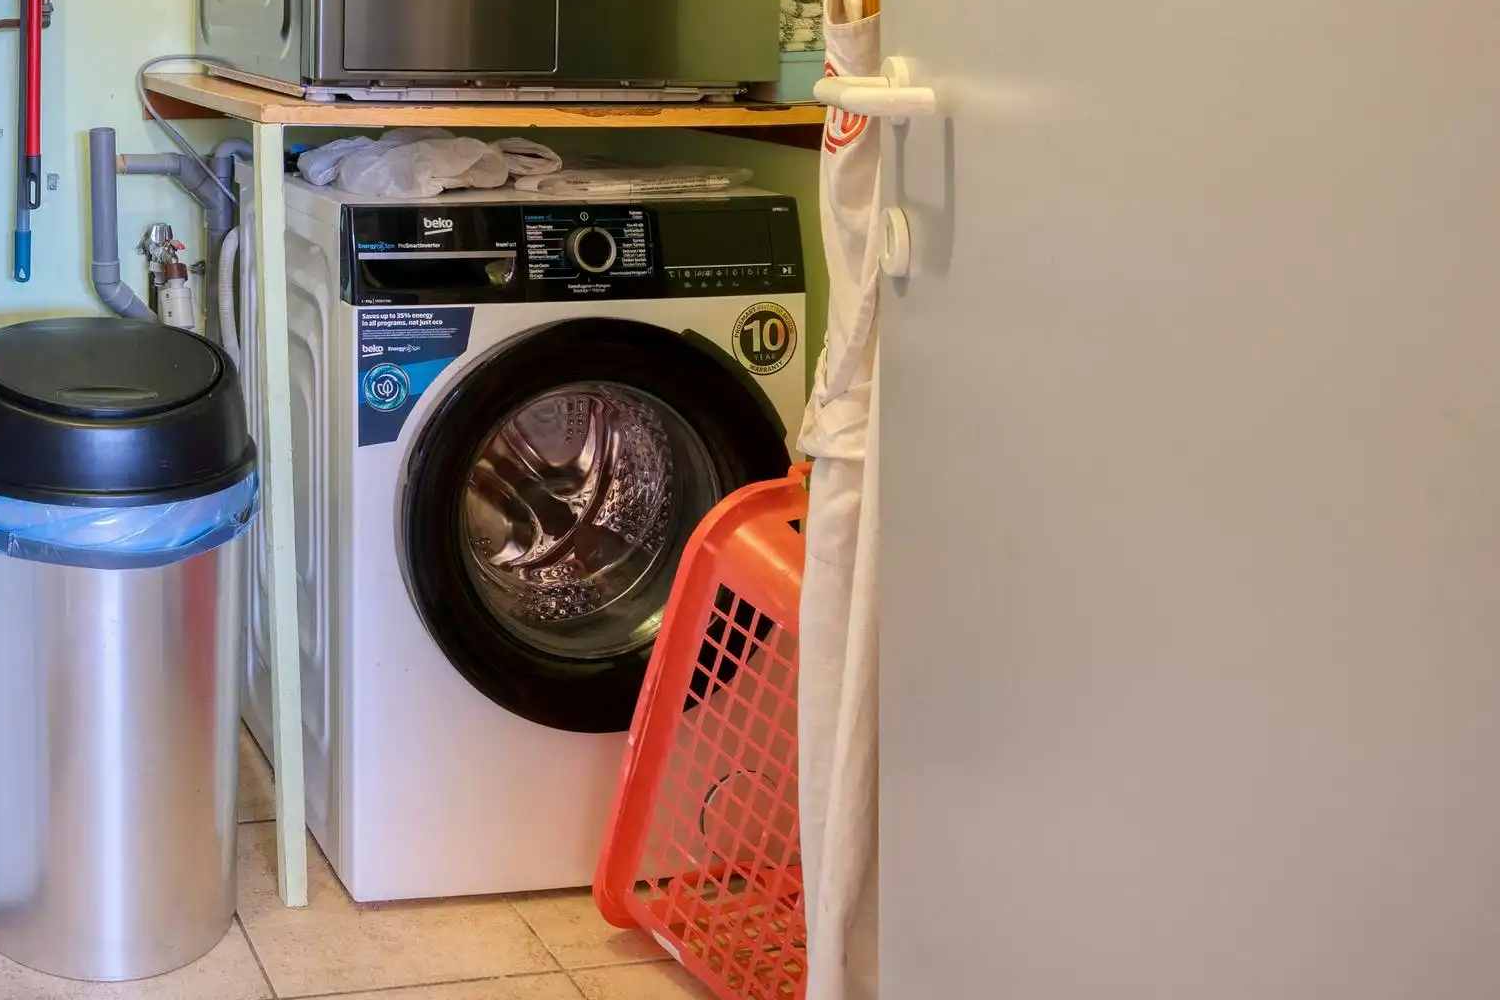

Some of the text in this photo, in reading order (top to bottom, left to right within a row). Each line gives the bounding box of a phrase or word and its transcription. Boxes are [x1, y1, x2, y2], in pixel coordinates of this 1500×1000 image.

[423, 217, 453, 229] beko
[412, 312, 433, 320] energy
[734, 307, 757, 338] PROSMART
[744, 318, 786, 353] 10
[362, 344, 384, 353] beko
[749, 361, 783, 373] WARRANTY
